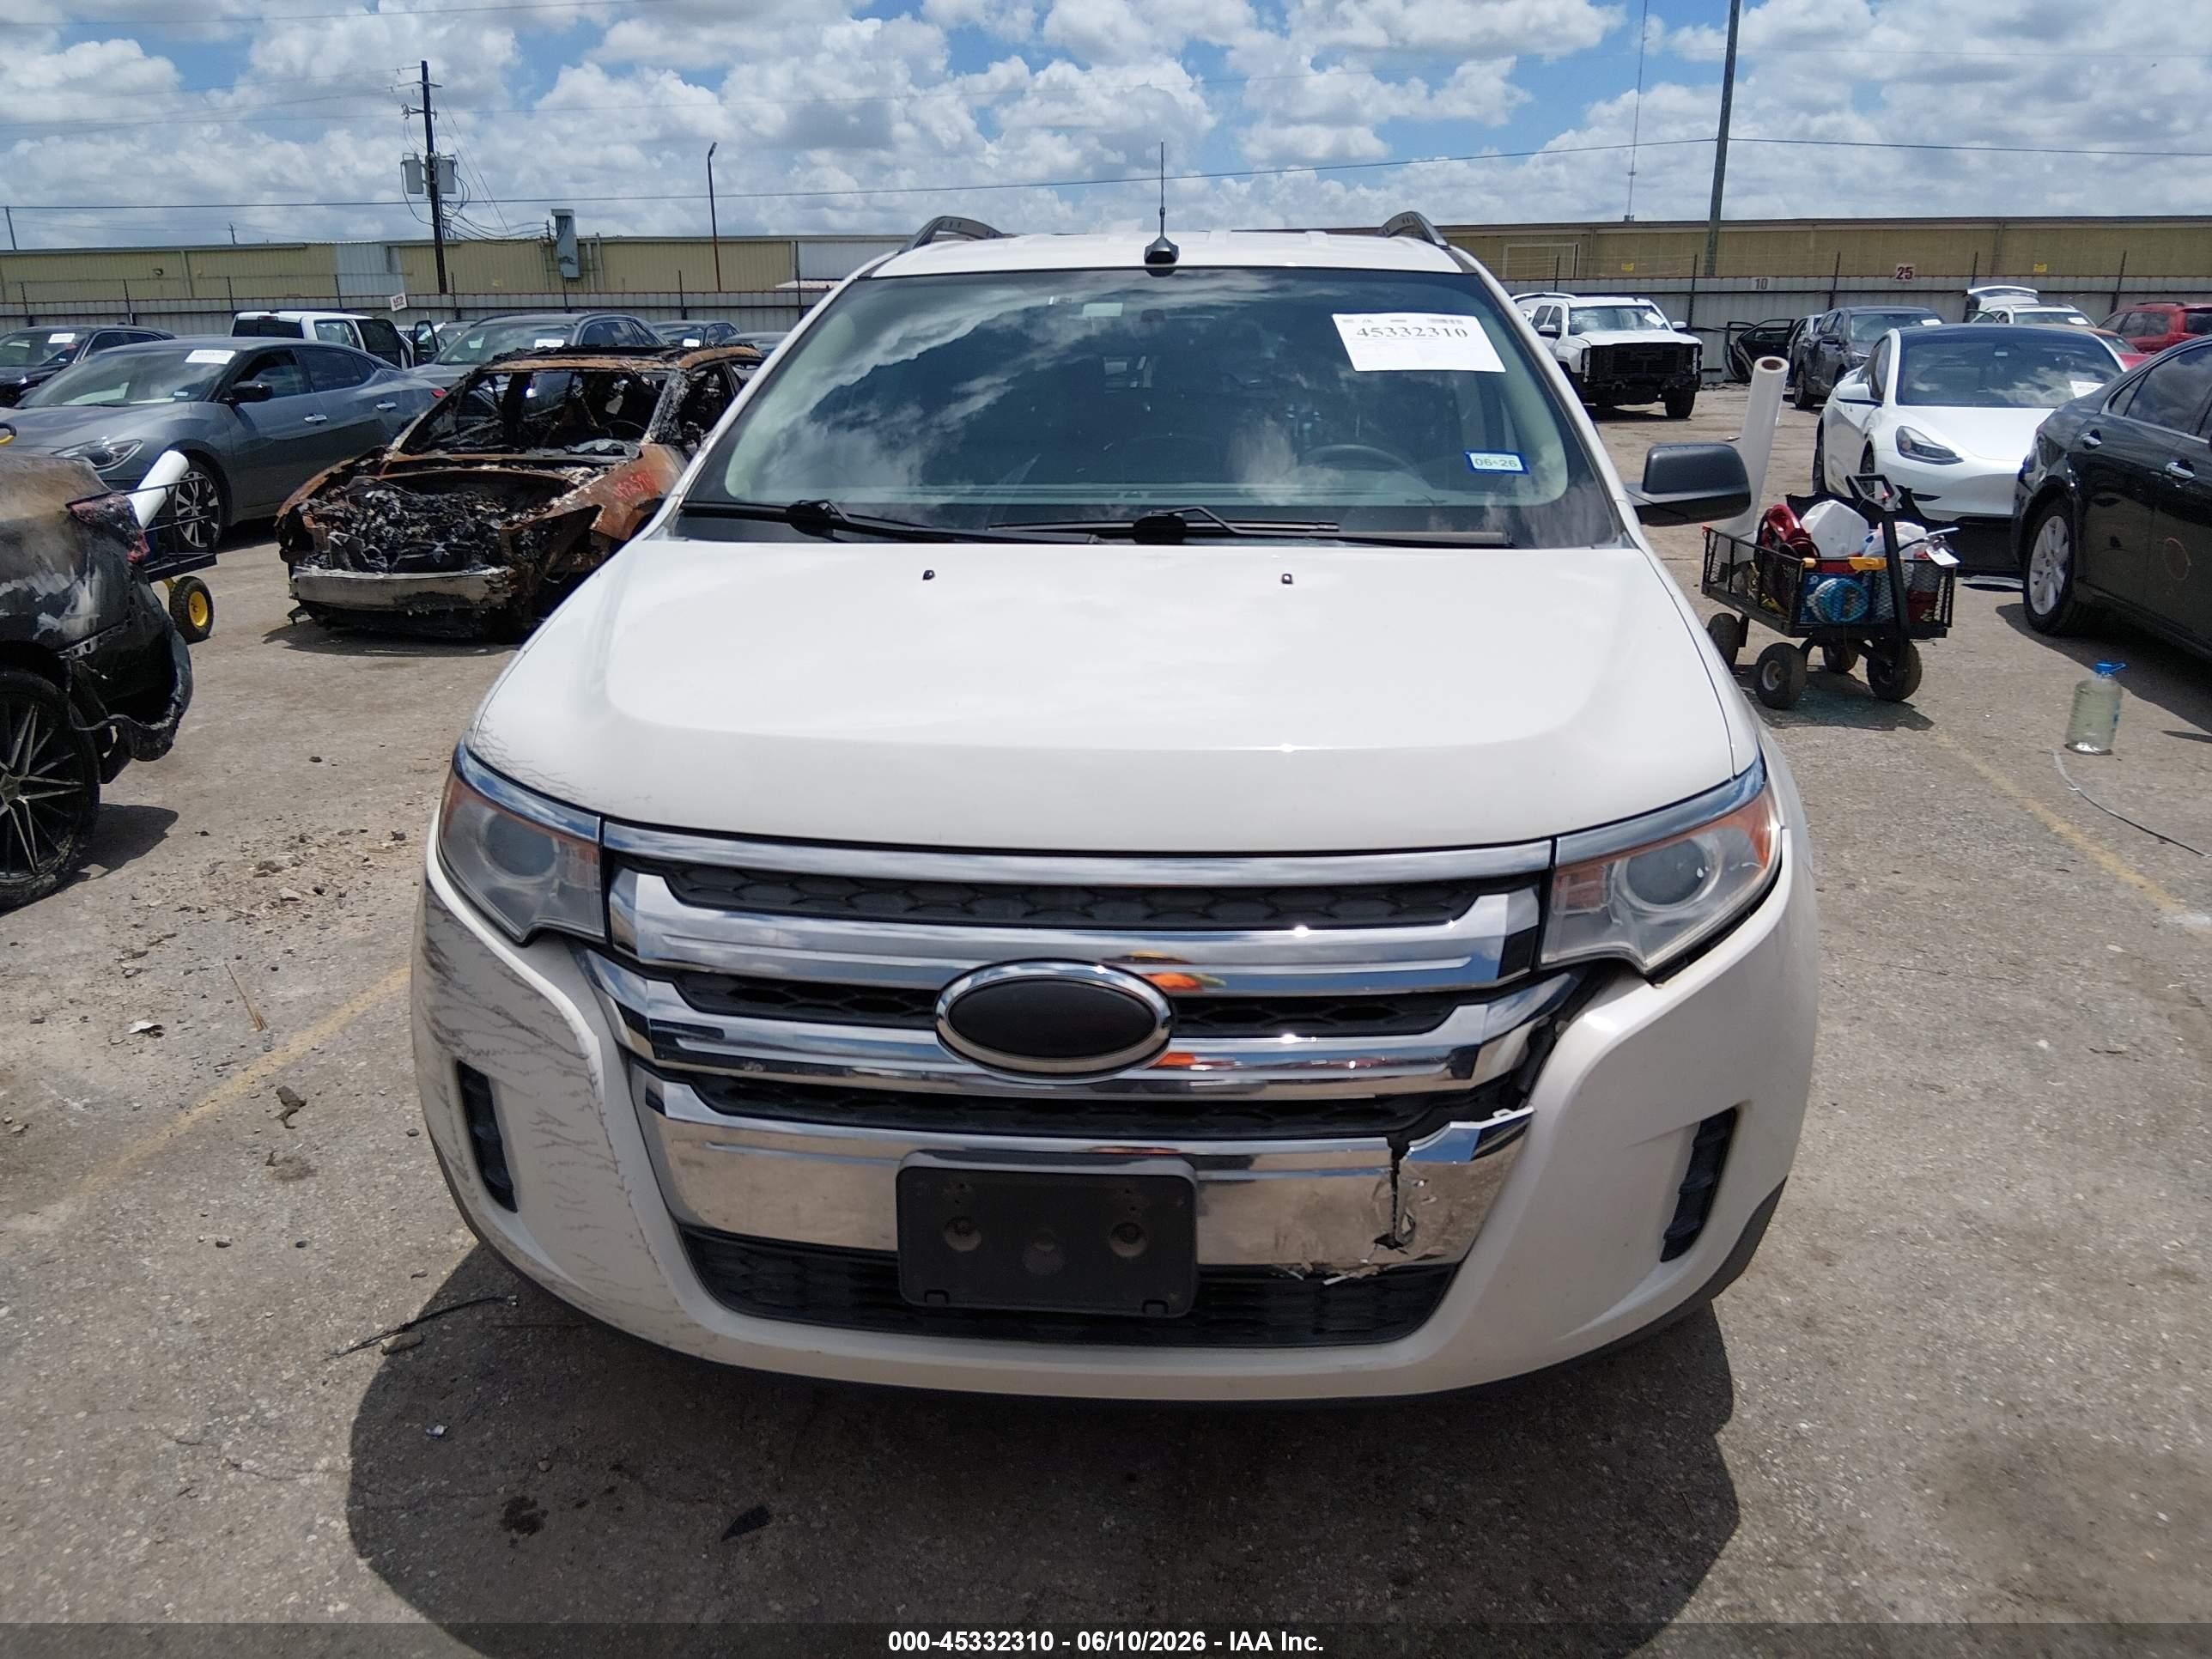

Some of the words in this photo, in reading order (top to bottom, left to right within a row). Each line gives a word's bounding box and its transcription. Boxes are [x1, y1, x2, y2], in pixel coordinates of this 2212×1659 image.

[1896, 266, 1913, 280] 25
[1755, 278, 1768, 290] 10
[1356, 326, 1468, 337] 45332310
